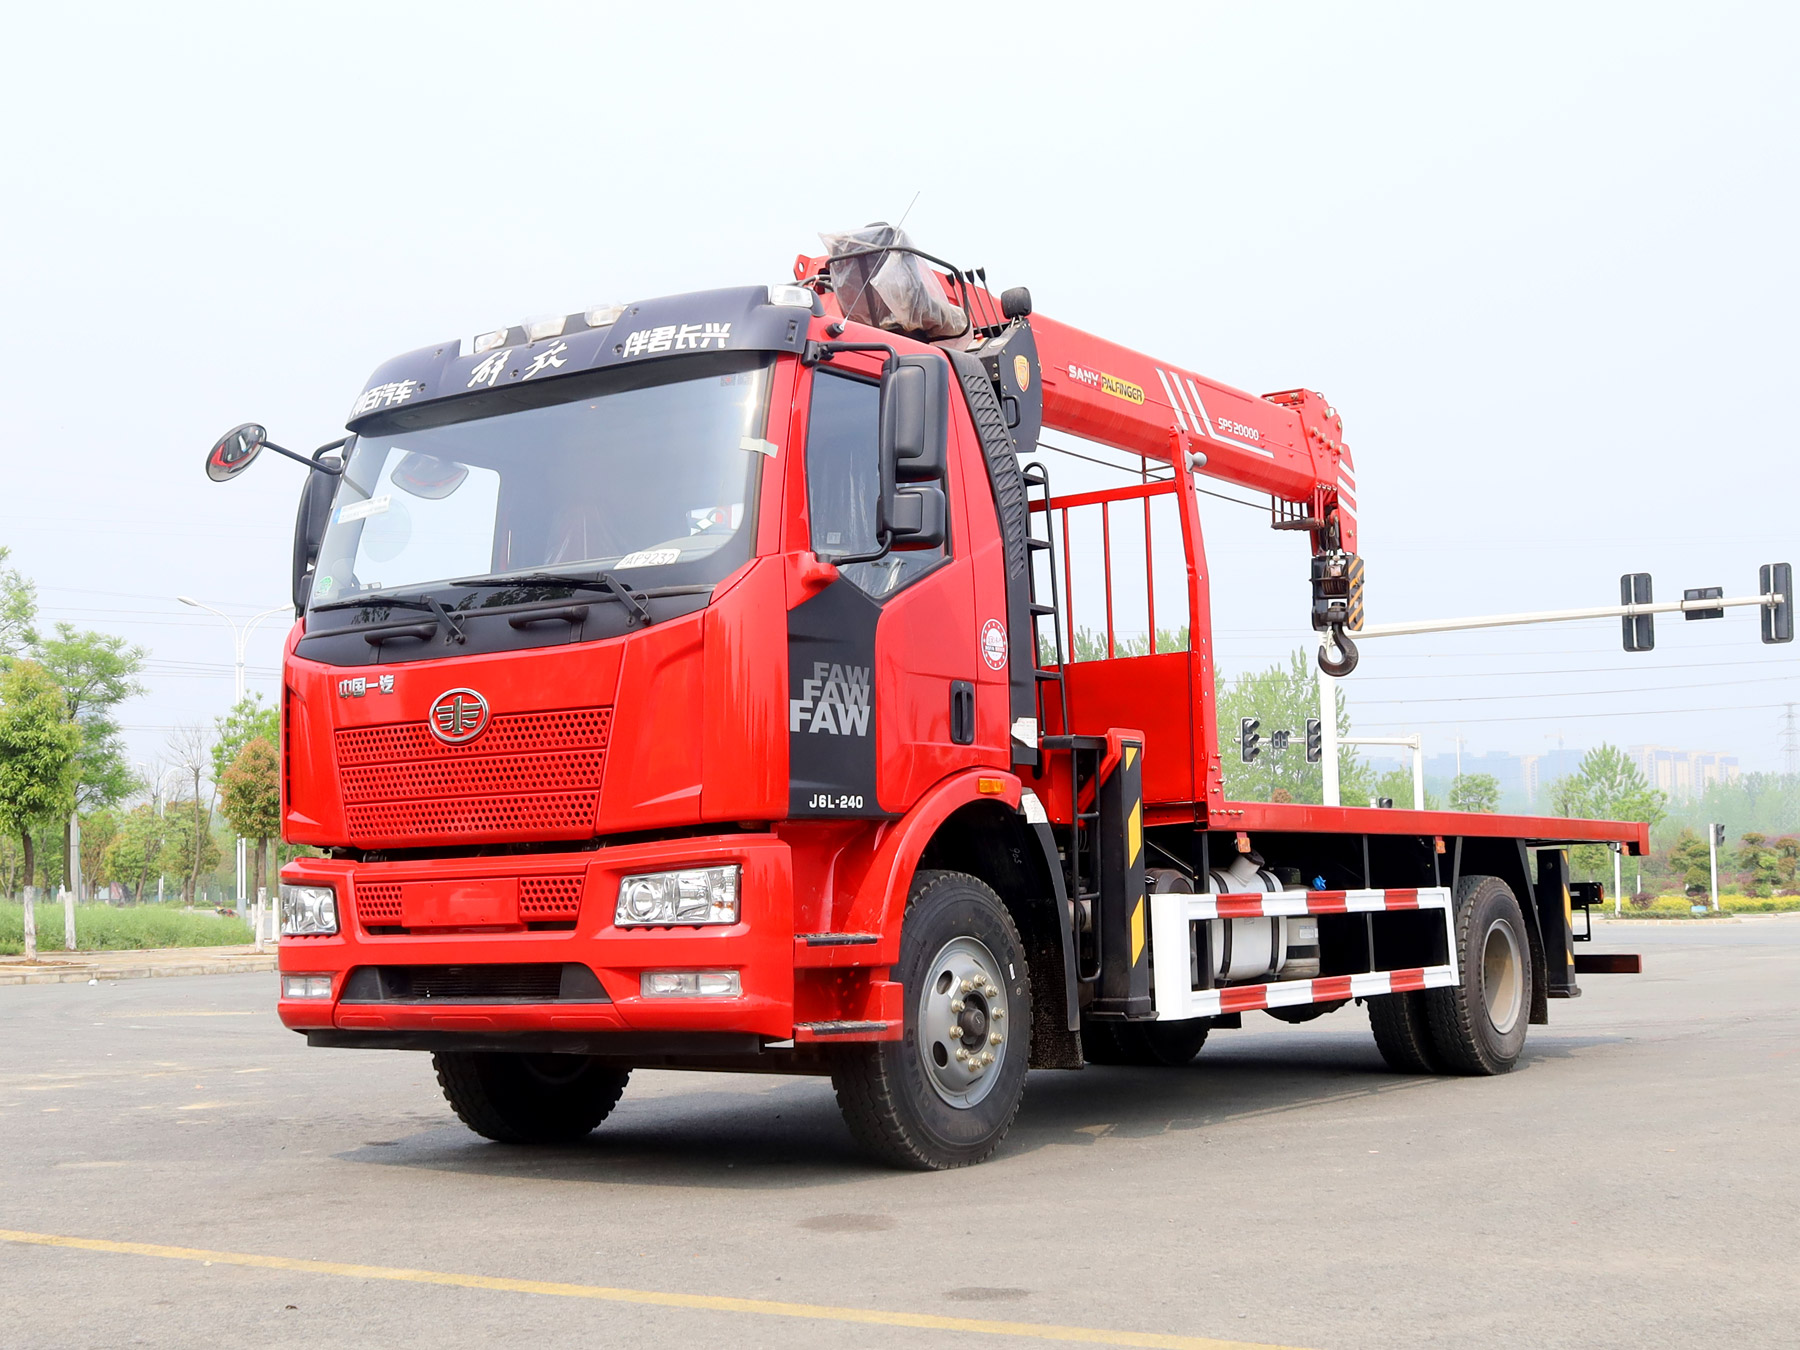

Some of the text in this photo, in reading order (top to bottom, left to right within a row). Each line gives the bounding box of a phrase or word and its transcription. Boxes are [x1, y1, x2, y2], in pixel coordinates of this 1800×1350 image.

[622, 322, 732, 358] 伴君长兴
[1067, 364, 1143, 402] SANY PALFINGER
[1218, 416, 1260, 441] SPS 20000
[339, 674, 395, 698] 中国一汽
[813, 661, 870, 690] FAW
[803, 678, 871, 711] FAW
[789, 698, 871, 737] FAW
[808, 793, 864, 809] J6L-240
